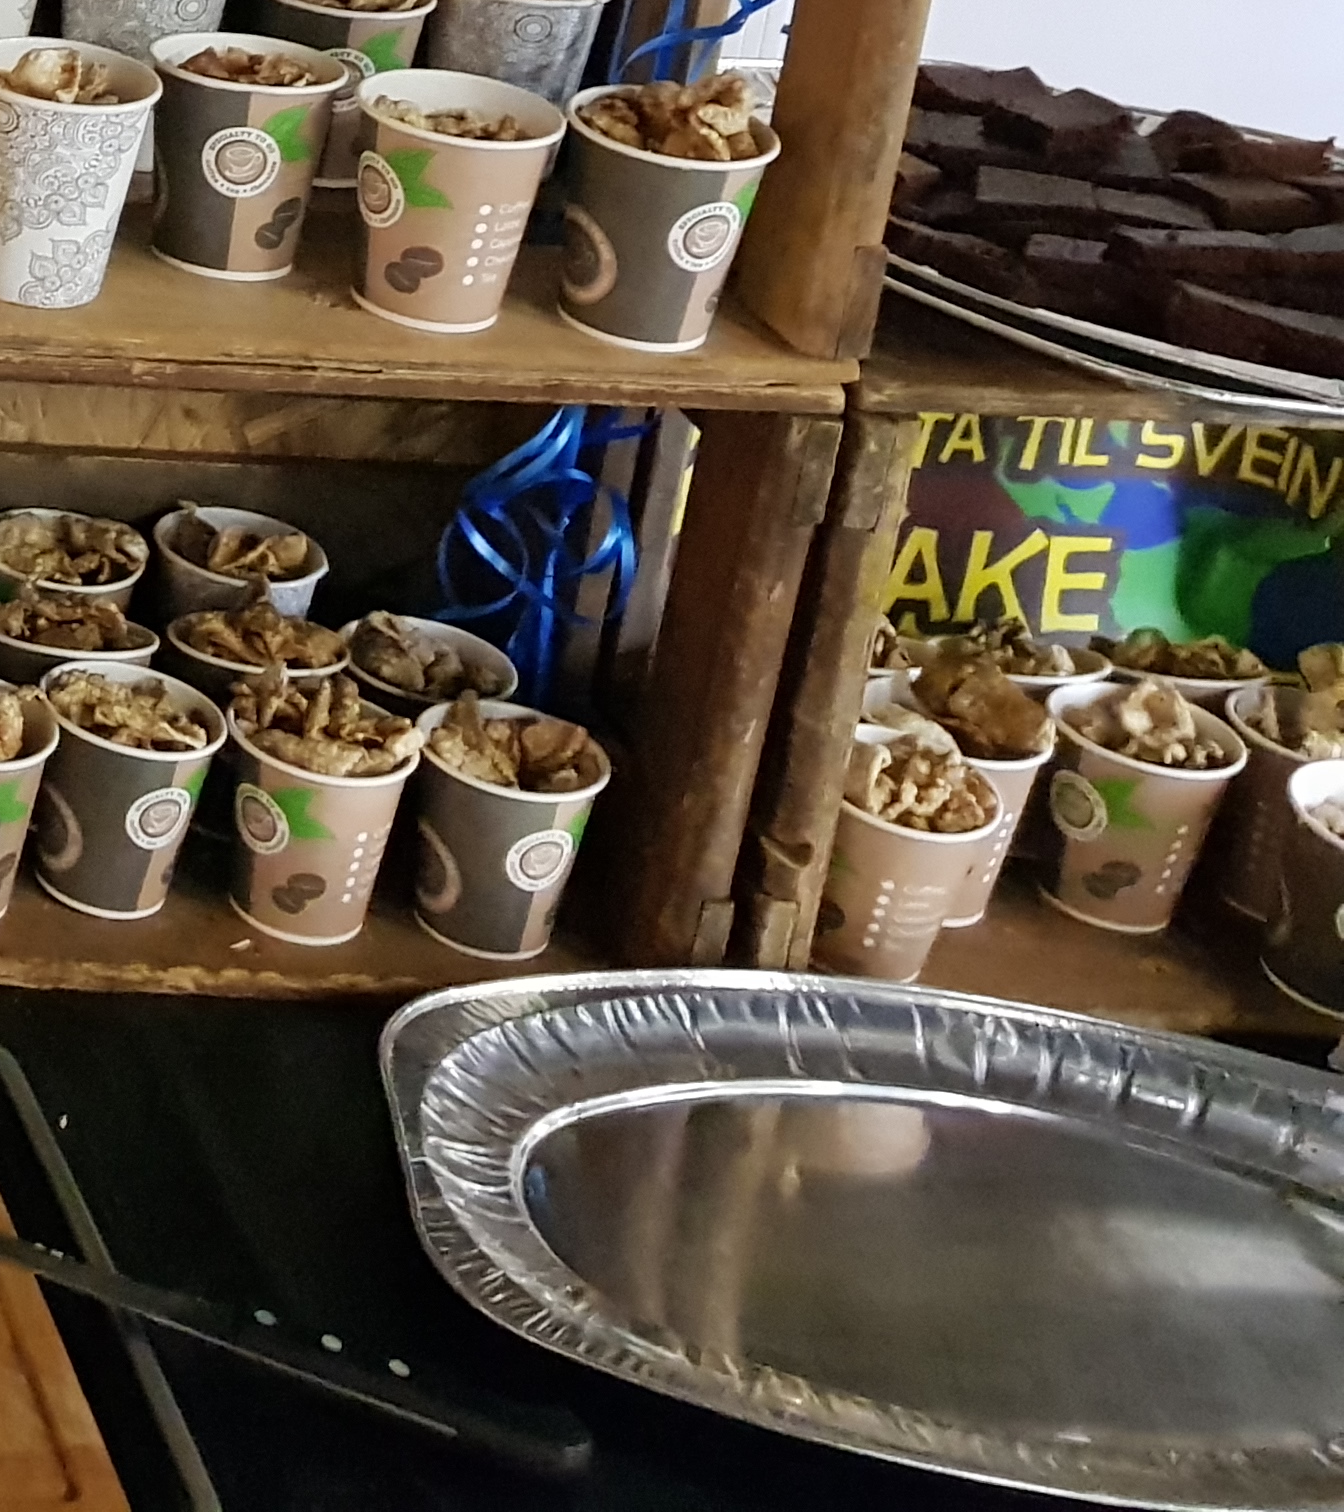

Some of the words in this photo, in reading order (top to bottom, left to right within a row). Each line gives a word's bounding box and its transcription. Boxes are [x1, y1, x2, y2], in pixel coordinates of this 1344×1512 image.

[1017, 415, 1109, 471] TIL
[1135, 419, 1343, 520] SVEIN
[882, 526, 1113, 635] AKE
